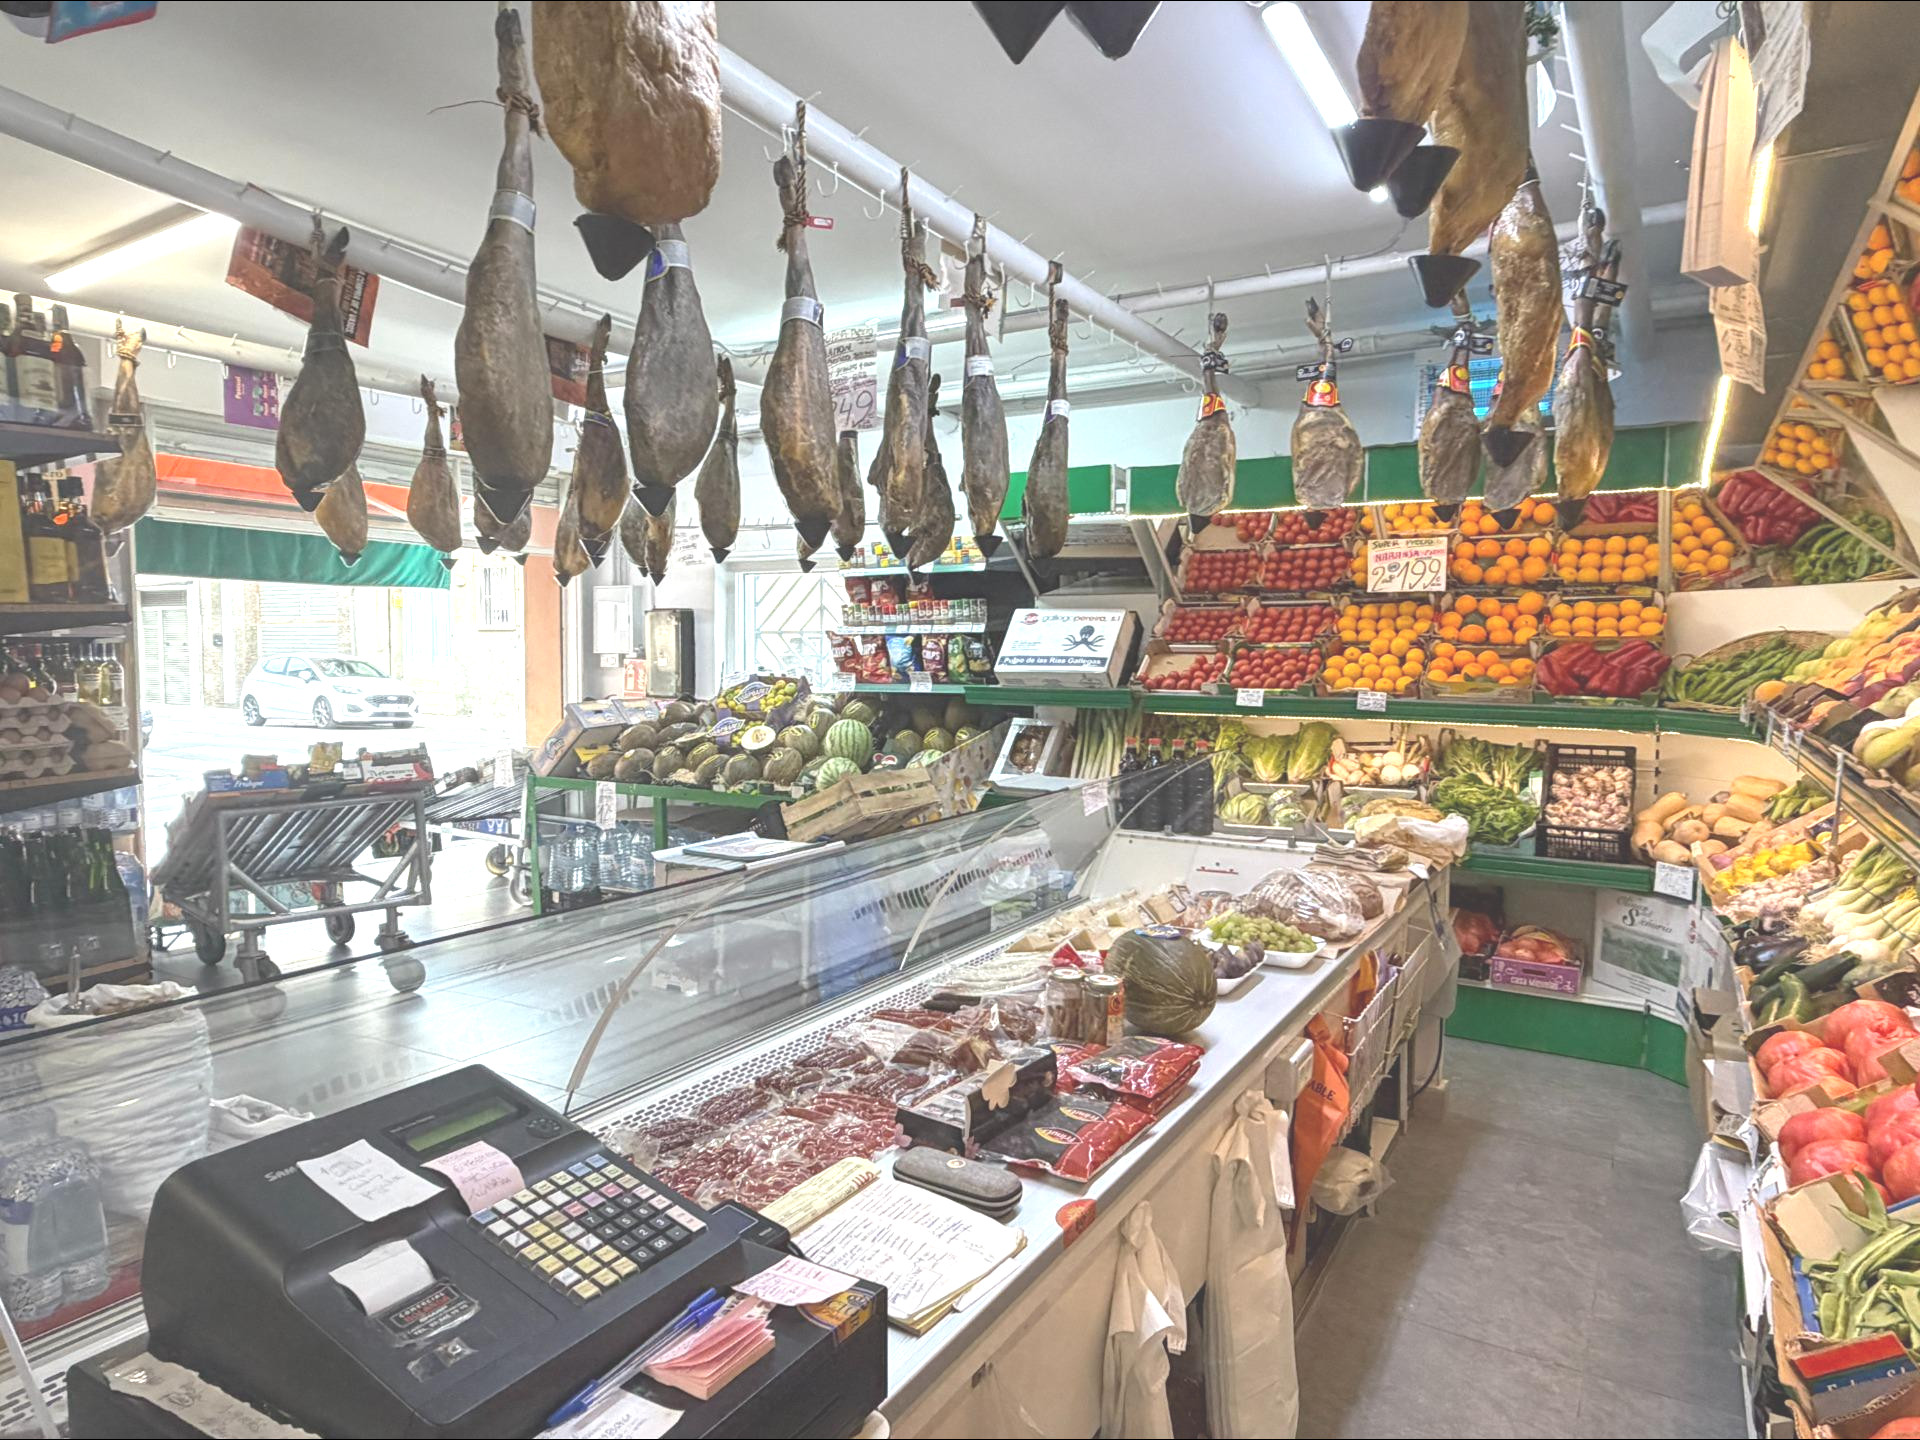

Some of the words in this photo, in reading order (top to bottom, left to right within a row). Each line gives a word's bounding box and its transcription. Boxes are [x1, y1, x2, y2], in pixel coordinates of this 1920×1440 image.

[922, 650, 941, 661] CHIPS
[1003, 656, 1024, 665] Pulpo
[1068, 657, 1101, 666] Gallegas
